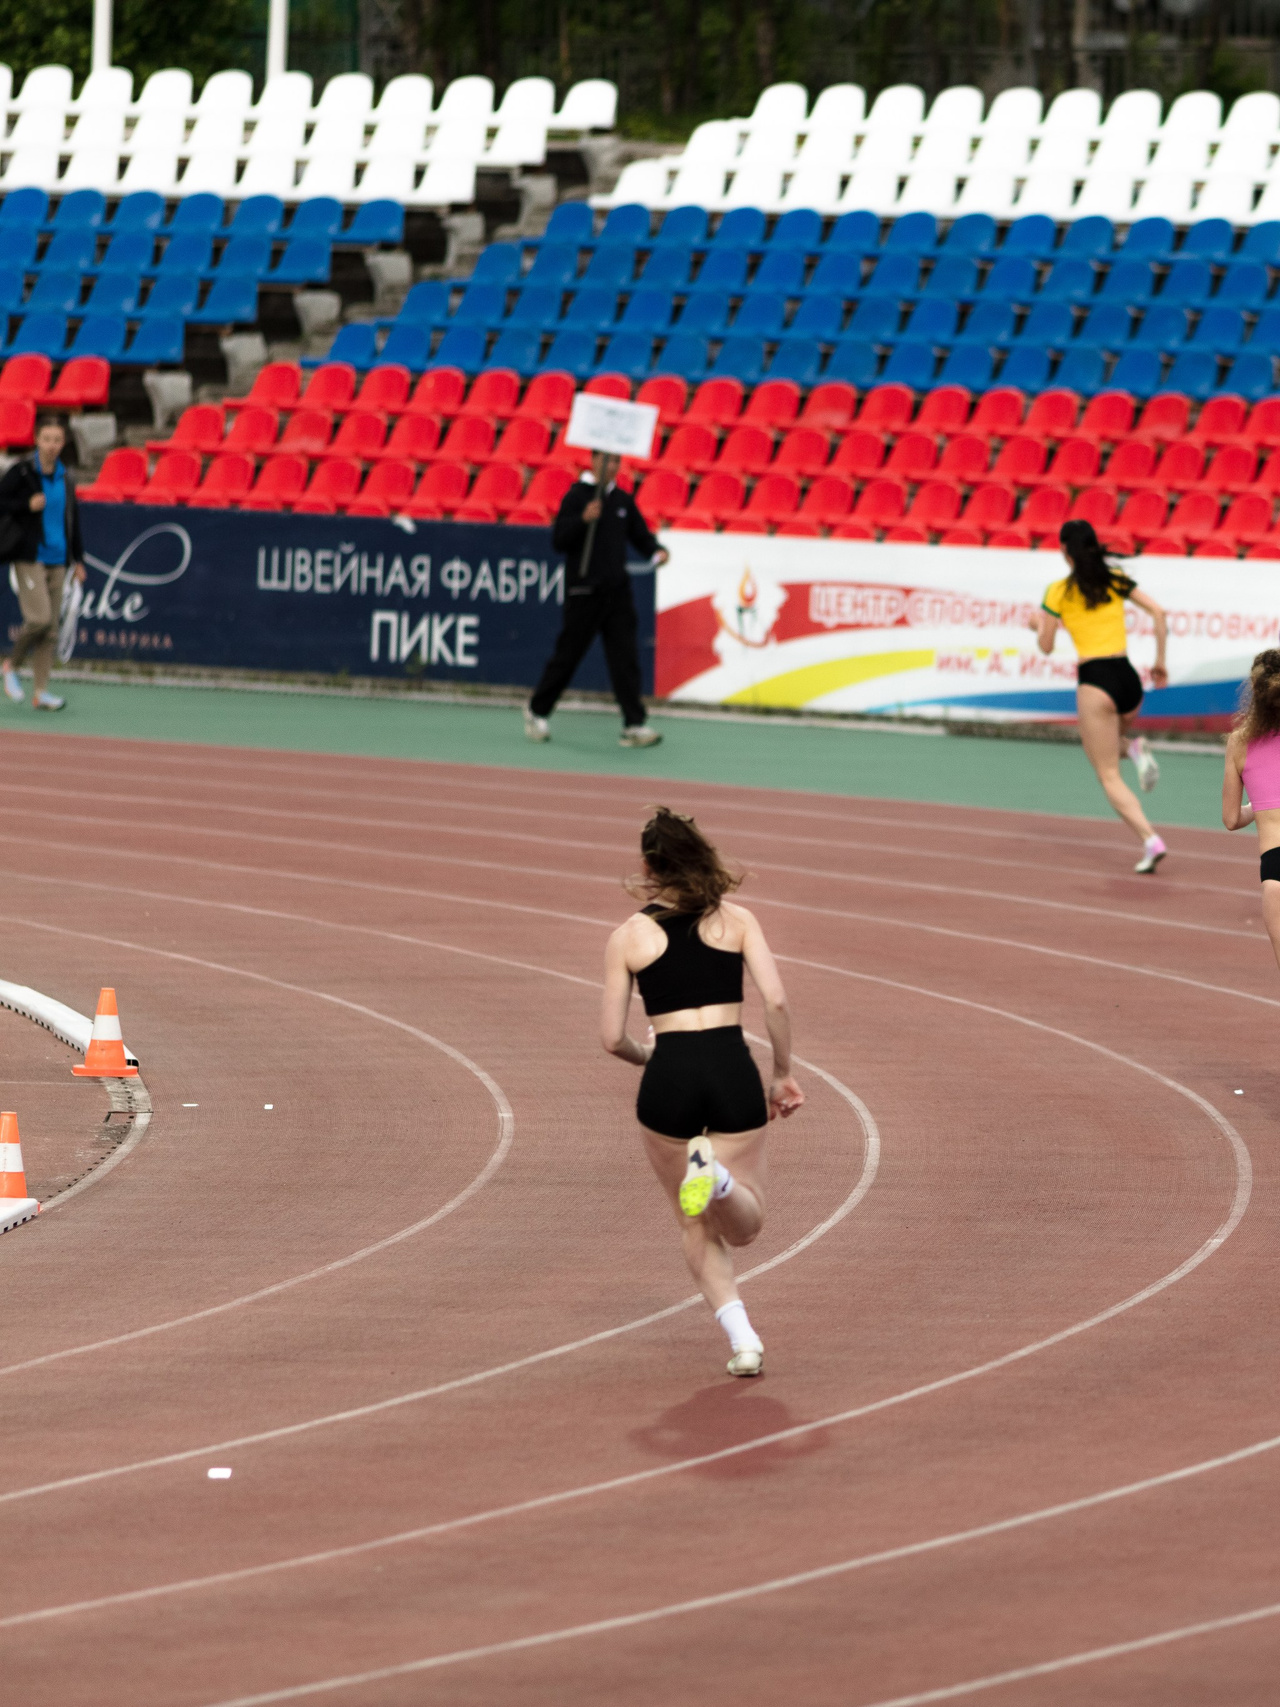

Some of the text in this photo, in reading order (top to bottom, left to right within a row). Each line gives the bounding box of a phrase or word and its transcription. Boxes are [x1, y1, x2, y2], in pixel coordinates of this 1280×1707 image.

[257, 542, 566, 605] ШВЕЙНАЯ ФАБРИ
[811, 585, 904, 627] ЦЕНТР
[370, 609, 480, 667] ПИКЕ
